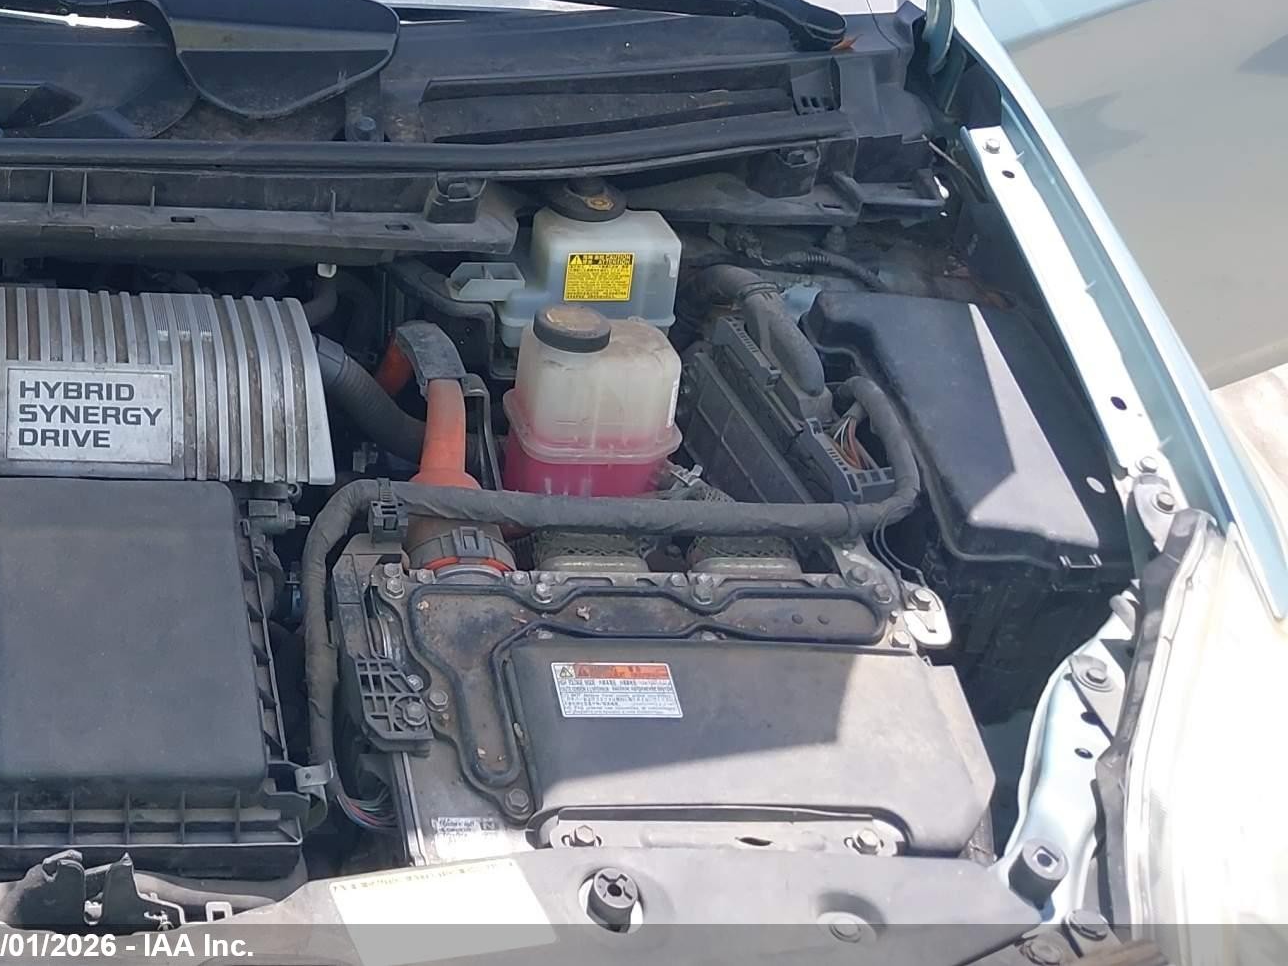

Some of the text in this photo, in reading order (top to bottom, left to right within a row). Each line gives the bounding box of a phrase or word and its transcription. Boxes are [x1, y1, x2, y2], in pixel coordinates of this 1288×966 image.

[19, 381, 135, 401] HYBRID
[18, 404, 163, 426] SYNERGY
[18, 429, 111, 449] DRIVE
